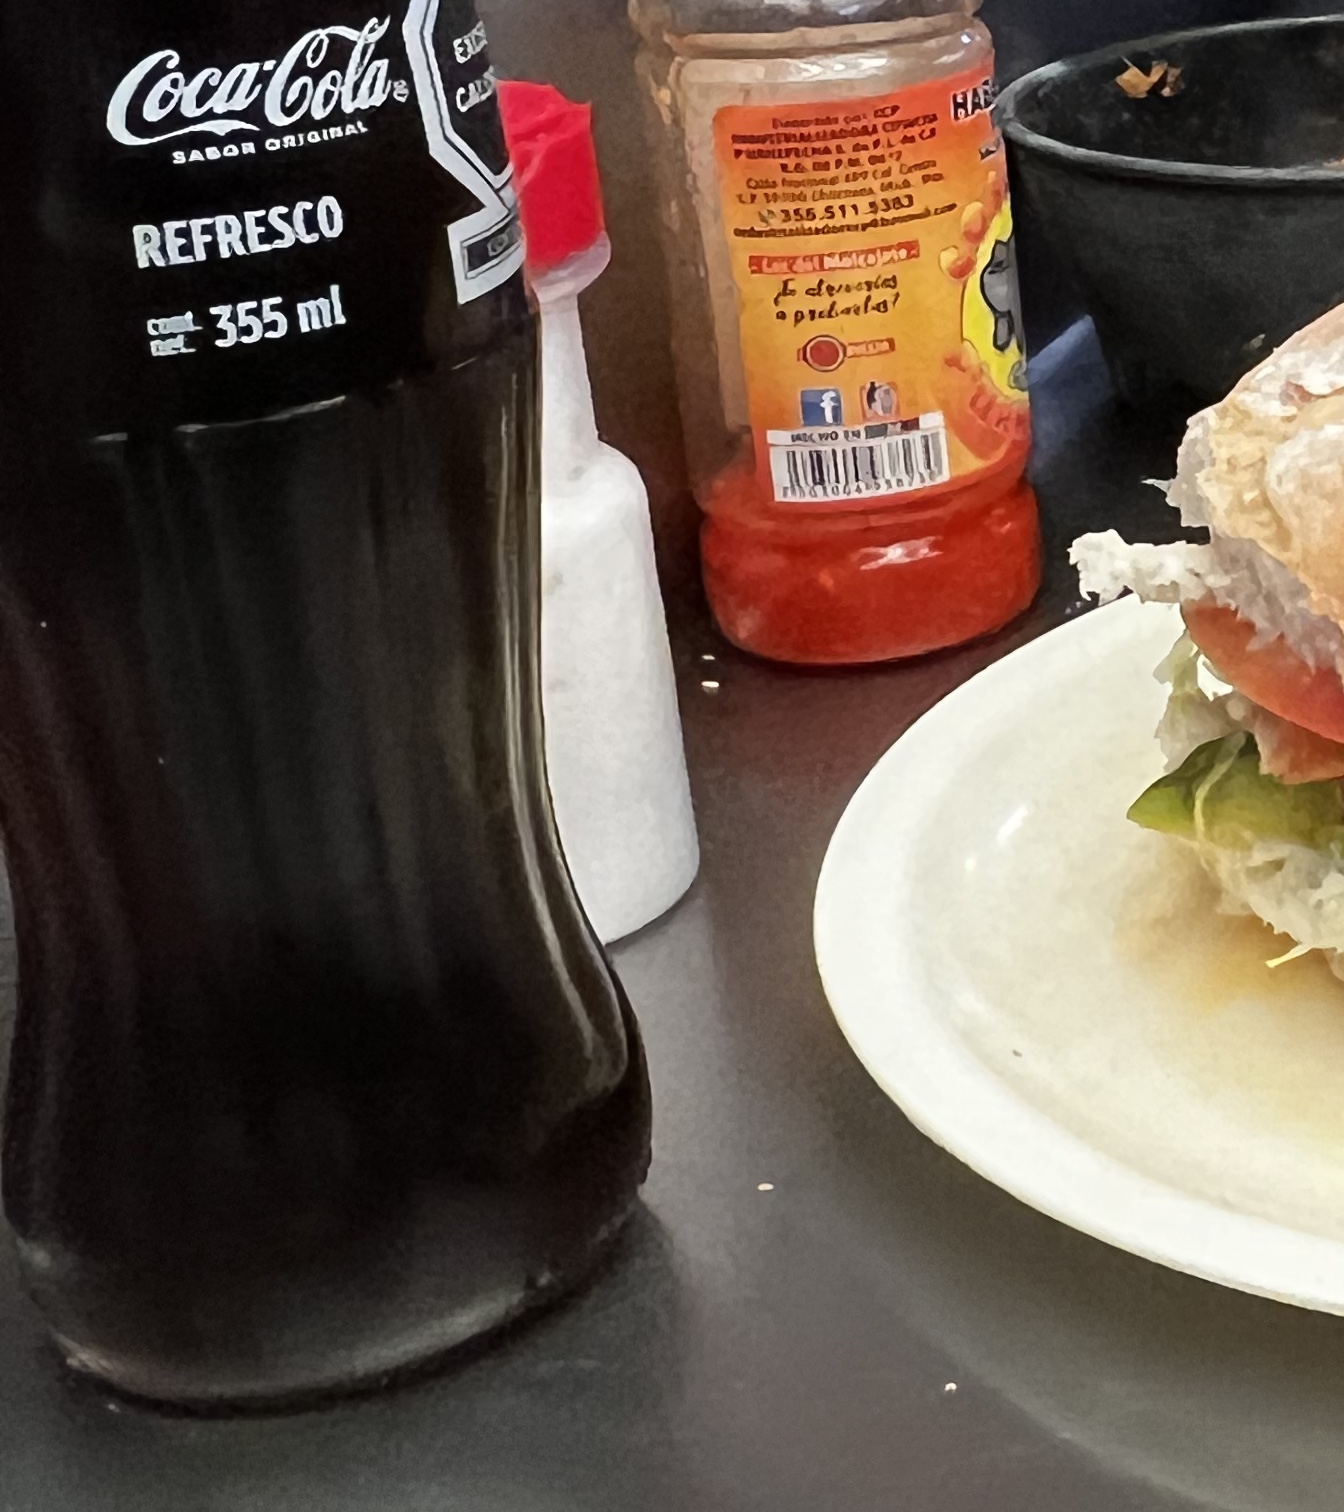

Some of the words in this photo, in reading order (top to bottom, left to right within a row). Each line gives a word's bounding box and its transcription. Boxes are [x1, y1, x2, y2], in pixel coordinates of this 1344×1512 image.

[107, 15, 390, 145] Coca-Cola
[172, 142, 256, 165] SABOR
[265, 121, 369, 151] ORIGINAL
[132, 195, 344, 269] REFRESCO
[209, 296, 288, 348] 355
[296, 284, 347, 333] ml
